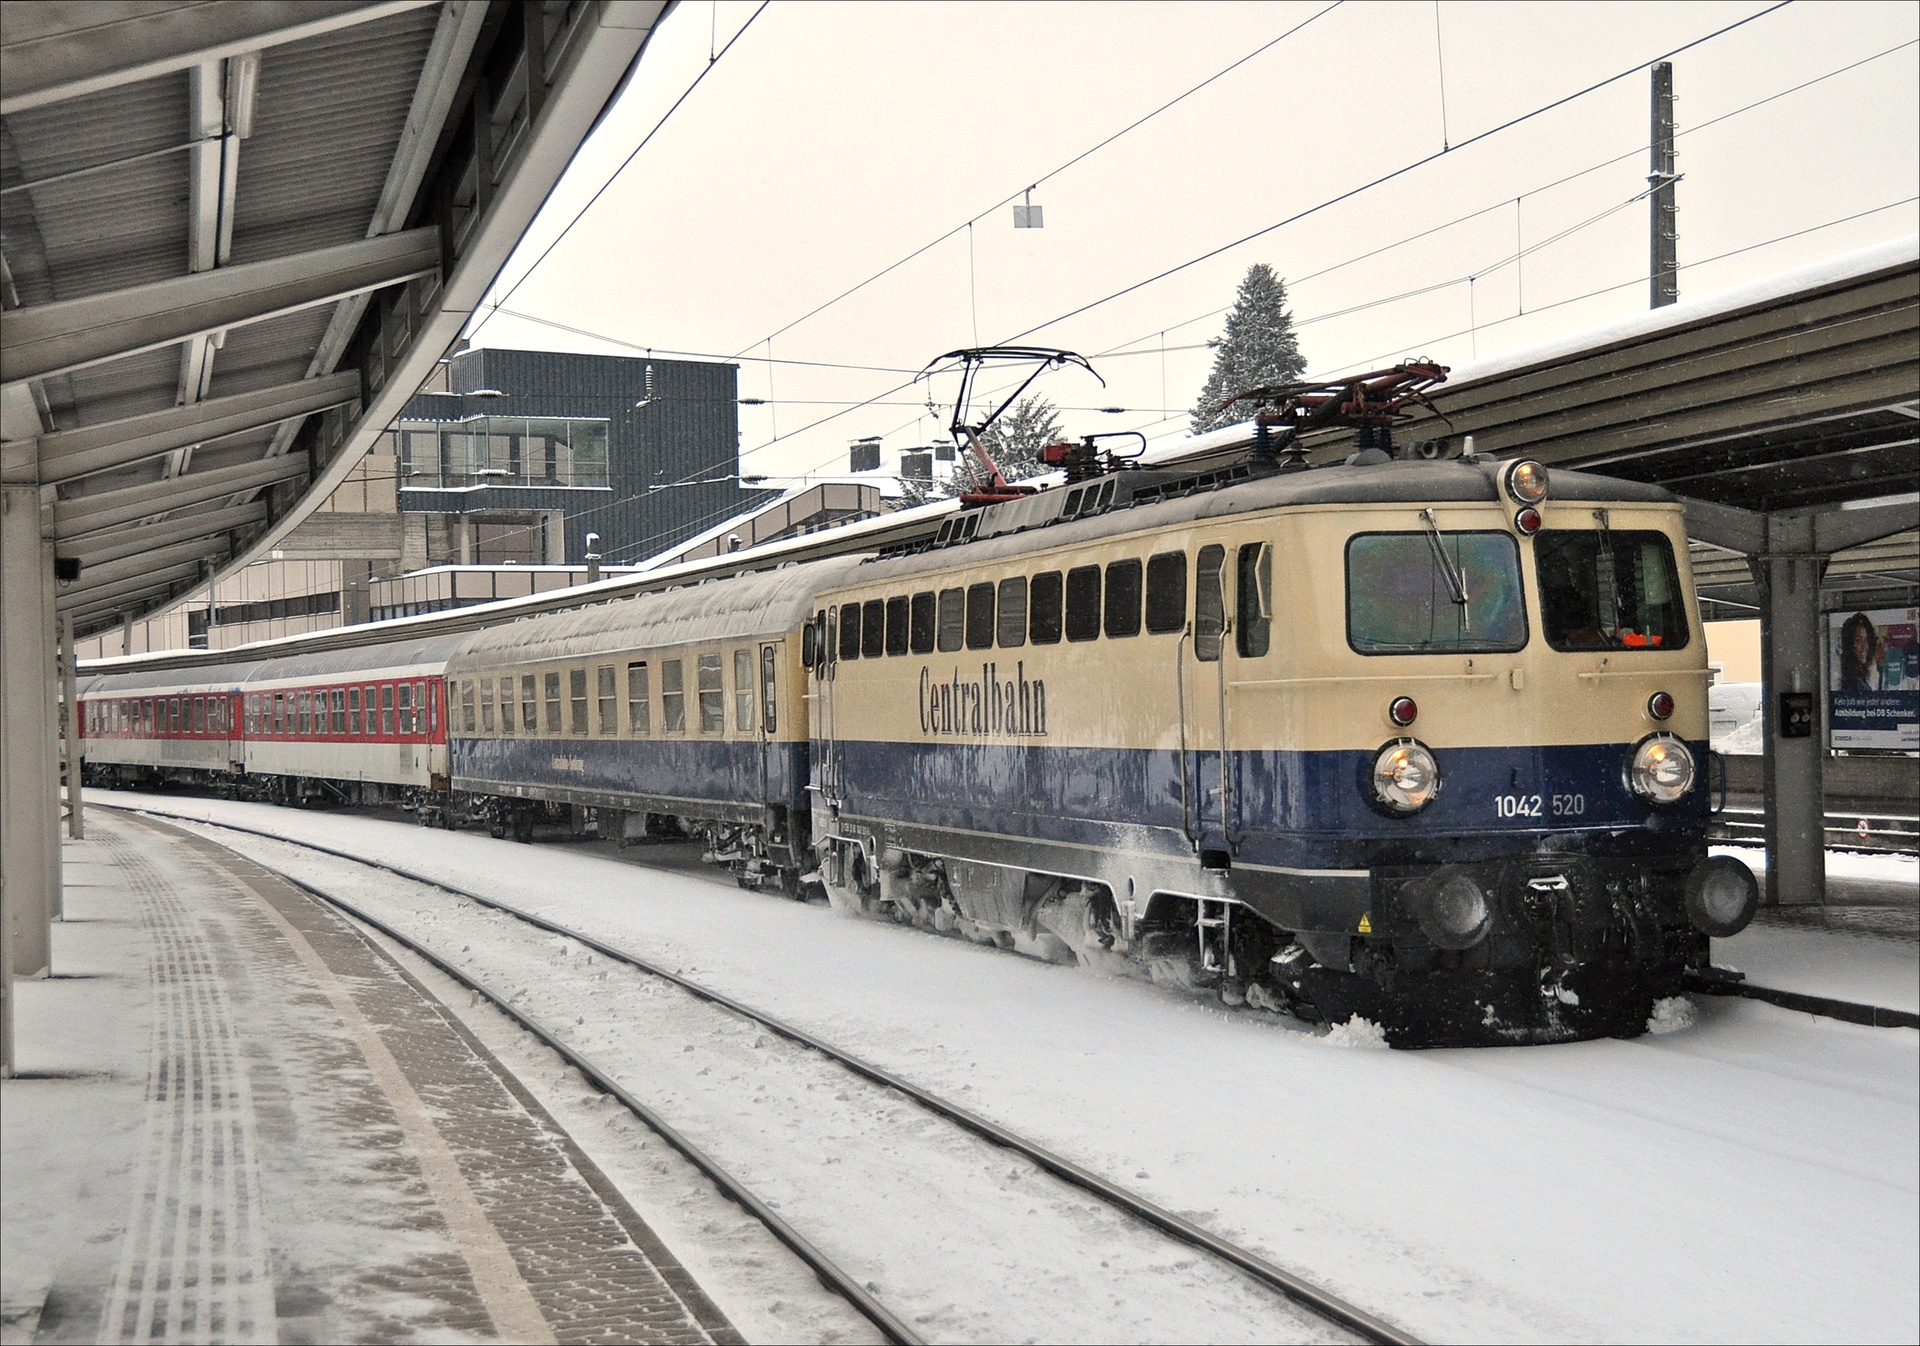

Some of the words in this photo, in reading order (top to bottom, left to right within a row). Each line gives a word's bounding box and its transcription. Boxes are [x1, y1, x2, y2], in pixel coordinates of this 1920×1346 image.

[919, 660, 1047, 737] Centralbahn
[1834, 697, 1846, 706] Kein
[1856, 697, 1866, 706] wie
[1866, 697, 1879, 707] jeder
[1834, 709, 1866, 719] Ausbildung
[1866, 709, 1876, 717] bei
[1876, 709, 1886, 717] DB
[1886, 709, 1916, 717] Schenker.
[1495, 795, 1543, 817] 1042
[1552, 793, 1584, 815] 520
